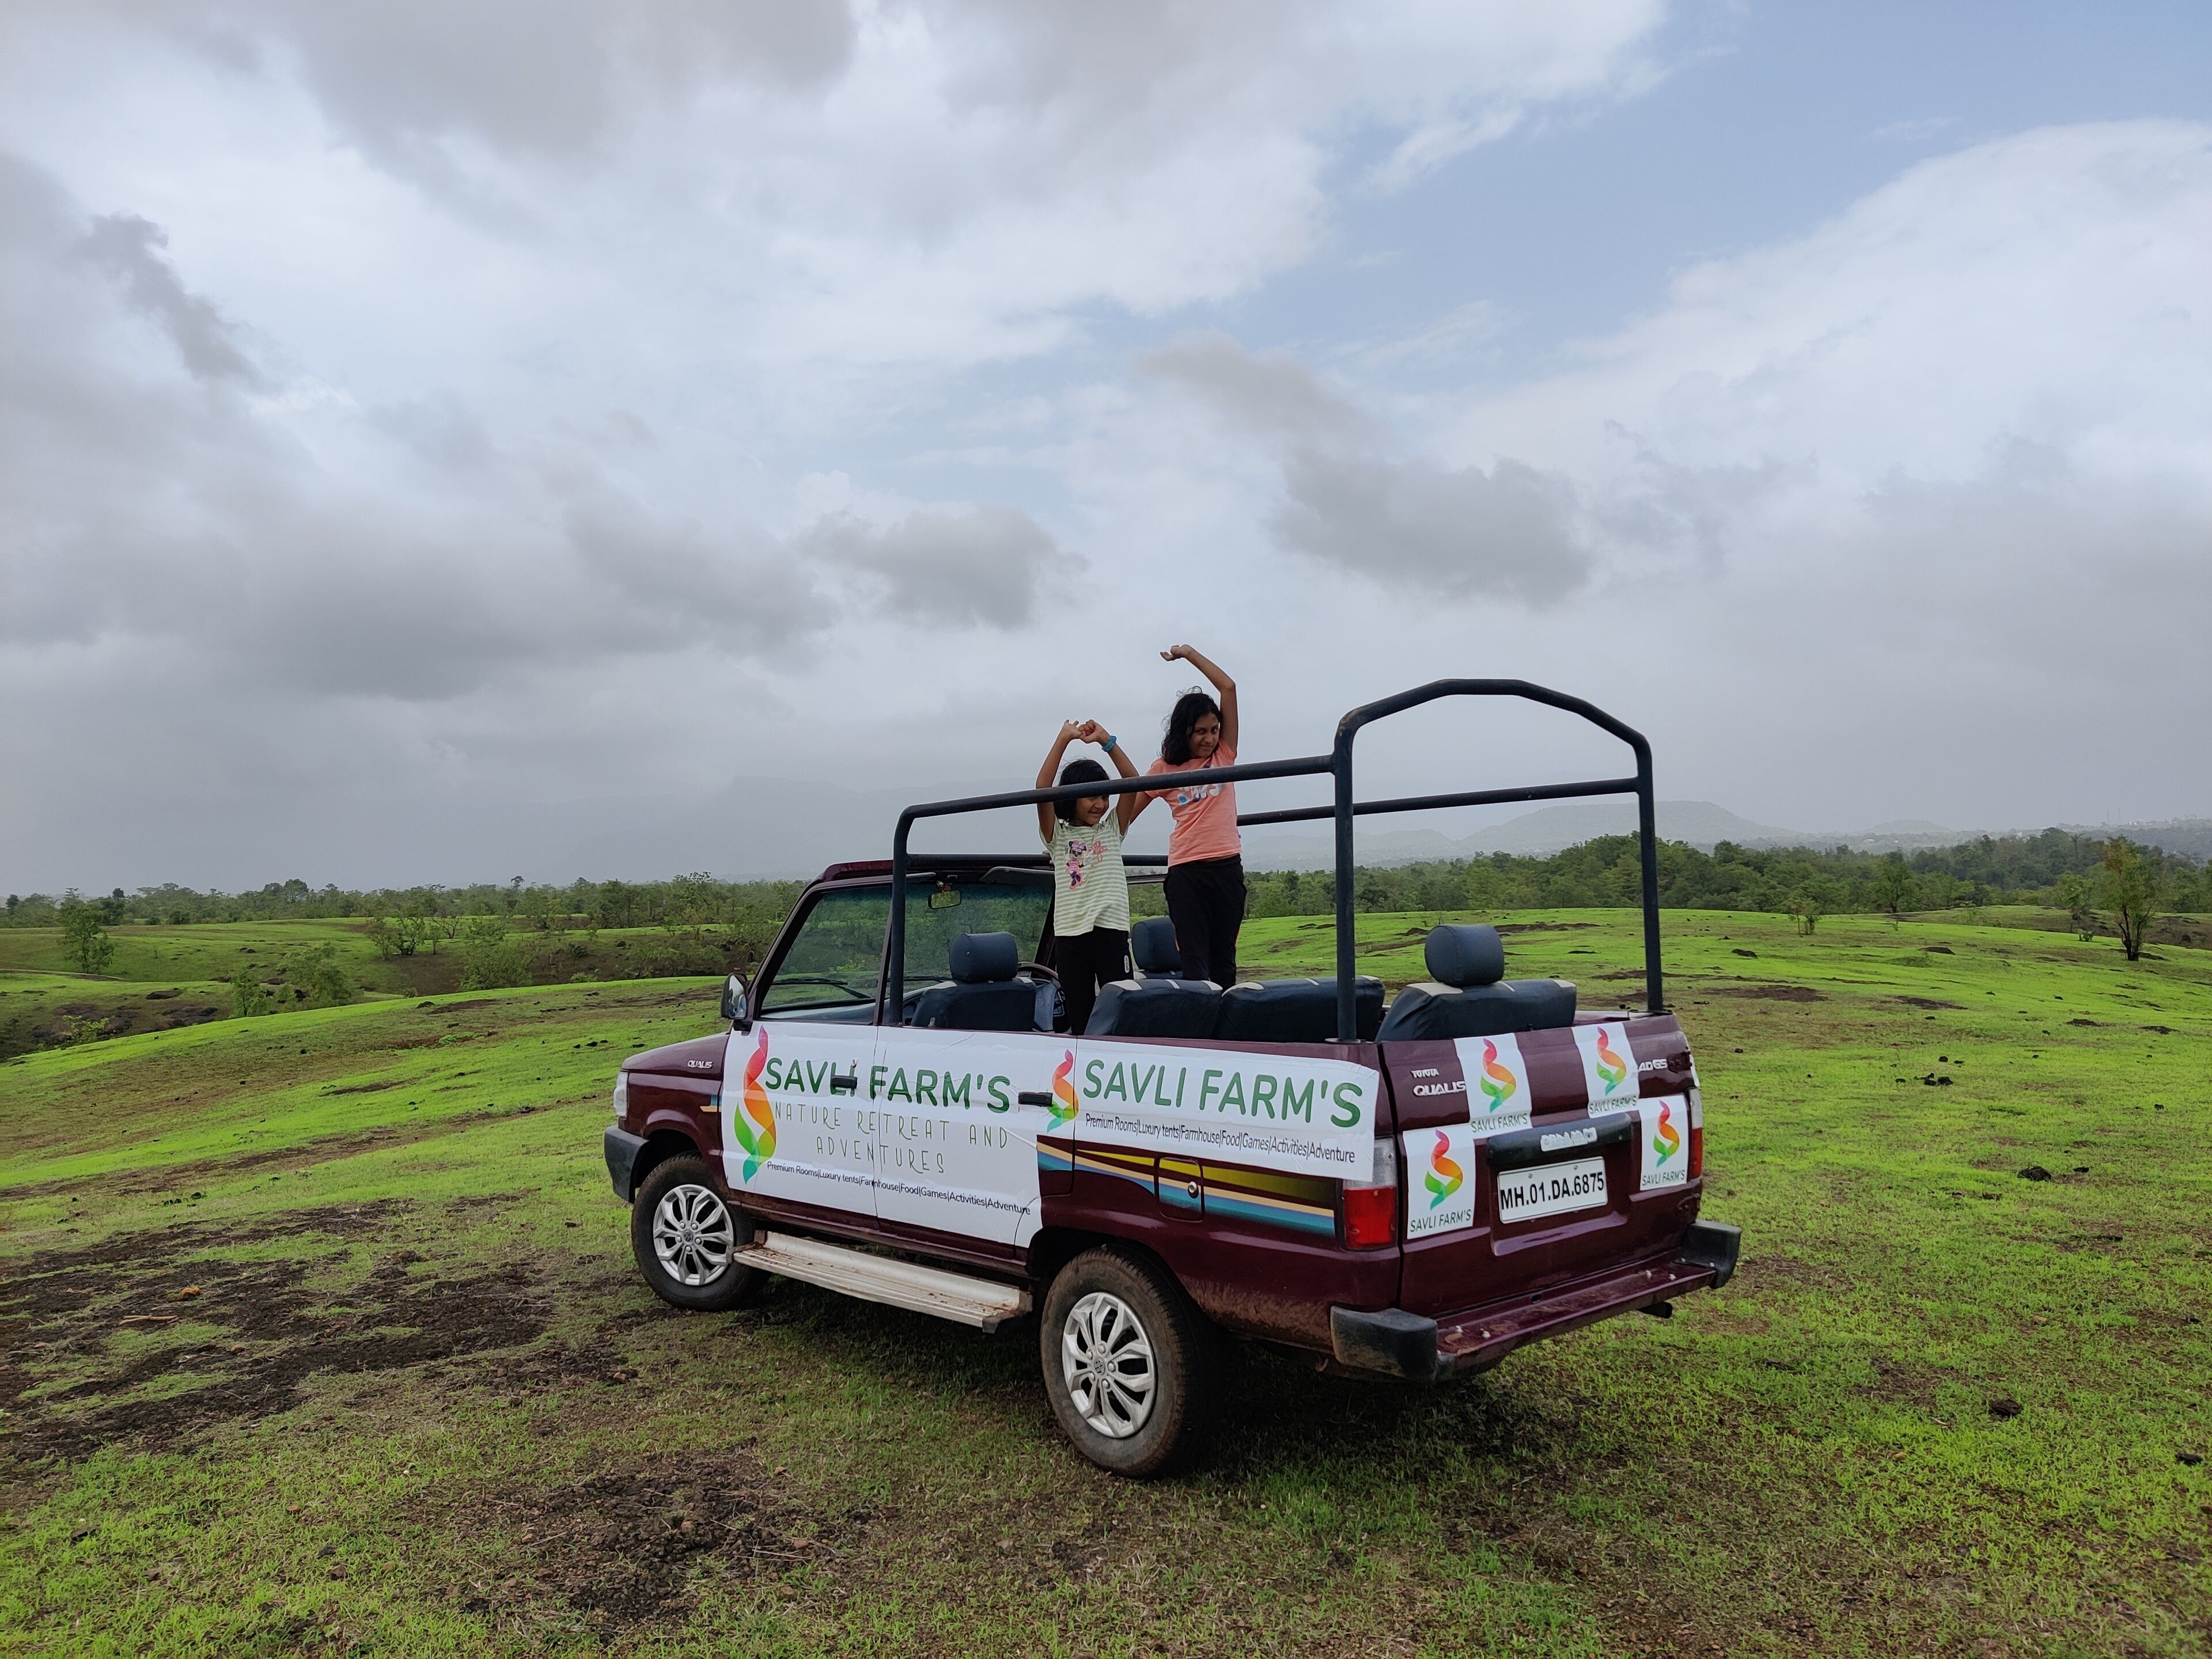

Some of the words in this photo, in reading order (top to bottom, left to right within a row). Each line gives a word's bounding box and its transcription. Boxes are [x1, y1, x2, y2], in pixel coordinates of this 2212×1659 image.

[687, 1059, 713, 1069] QUALIS
[1411, 1068, 1440, 1078] TOYOTA
[870, 1065, 1010, 1113] FARM'S
[1083, 1059, 1187, 1107] SAVLI
[1199, 1069, 1363, 1128] FARM'S
[1413, 1081, 1467, 1096] QUALIS
[1589, 1101, 1609, 1115] SAVLI
[1611, 1096, 1637, 1111] FARM'S
[775, 1101, 841, 1130] NATURE
[857, 1110, 949, 1141] RETREAT
[969, 1124, 1007, 1149] AND
[1085, 1113, 1113, 1130] Premium
[1471, 1118, 1496, 1133] SAVLI
[1498, 1113, 1528, 1129] FARM'S
[816, 1136, 944, 1174] ADVENTURES
[767, 1161, 794, 1173] Premium
[1642, 1173, 1661, 1186] SAVLI
[1499, 1172, 1604, 1210] MH.01.DA.6875
[1410, 1215, 1437, 1233] SAVLI
[1438, 1209, 1472, 1227] FARM'S
